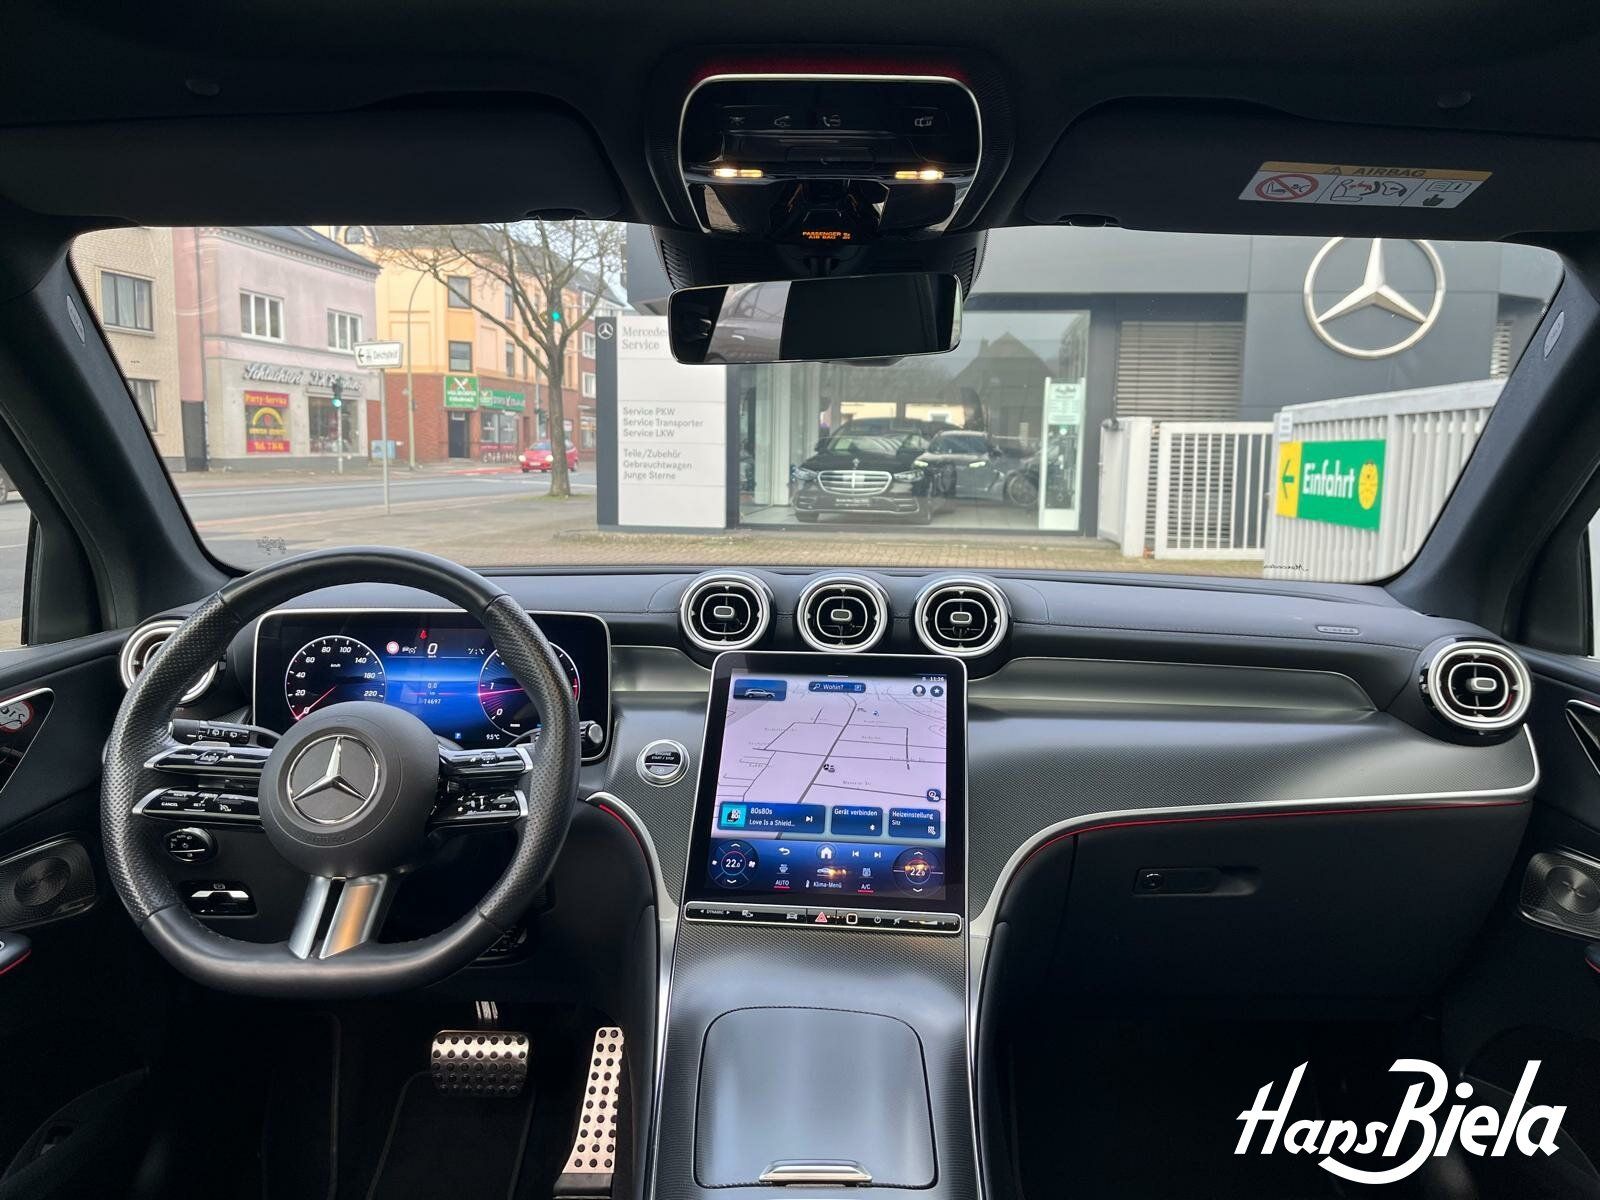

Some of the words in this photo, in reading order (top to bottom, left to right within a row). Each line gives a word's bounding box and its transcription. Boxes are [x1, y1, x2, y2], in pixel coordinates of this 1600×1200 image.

[1352, 167, 1426, 177] AIRBAG
[622, 339, 660, 350] Service
[623, 407, 653, 416] Service
[656, 407, 676, 416] PKW
[623, 418, 653, 427] Service
[656, 418, 703, 428] Transporter
[623, 428, 653, 437] Service
[656, 429, 675, 437] LKW
[623, 448, 681, 459] Teile/Zubehör
[623, 460, 692, 471] Gebrauchtwagen
[623, 470, 647, 480] Junge
[649, 471, 676, 480] Sterne
[1302, 459, 1354, 499] Einfahrt
[427, 643, 438, 654] 0
[489, 682, 495, 690] 1
[295, 689, 306, 697] 20
[496, 708, 504, 716] 0
[750, 807, 773, 815] 80s80s
[892, 811, 934, 820] Heizeinstellung
[813, 880, 842, 889] Klima-Menü
